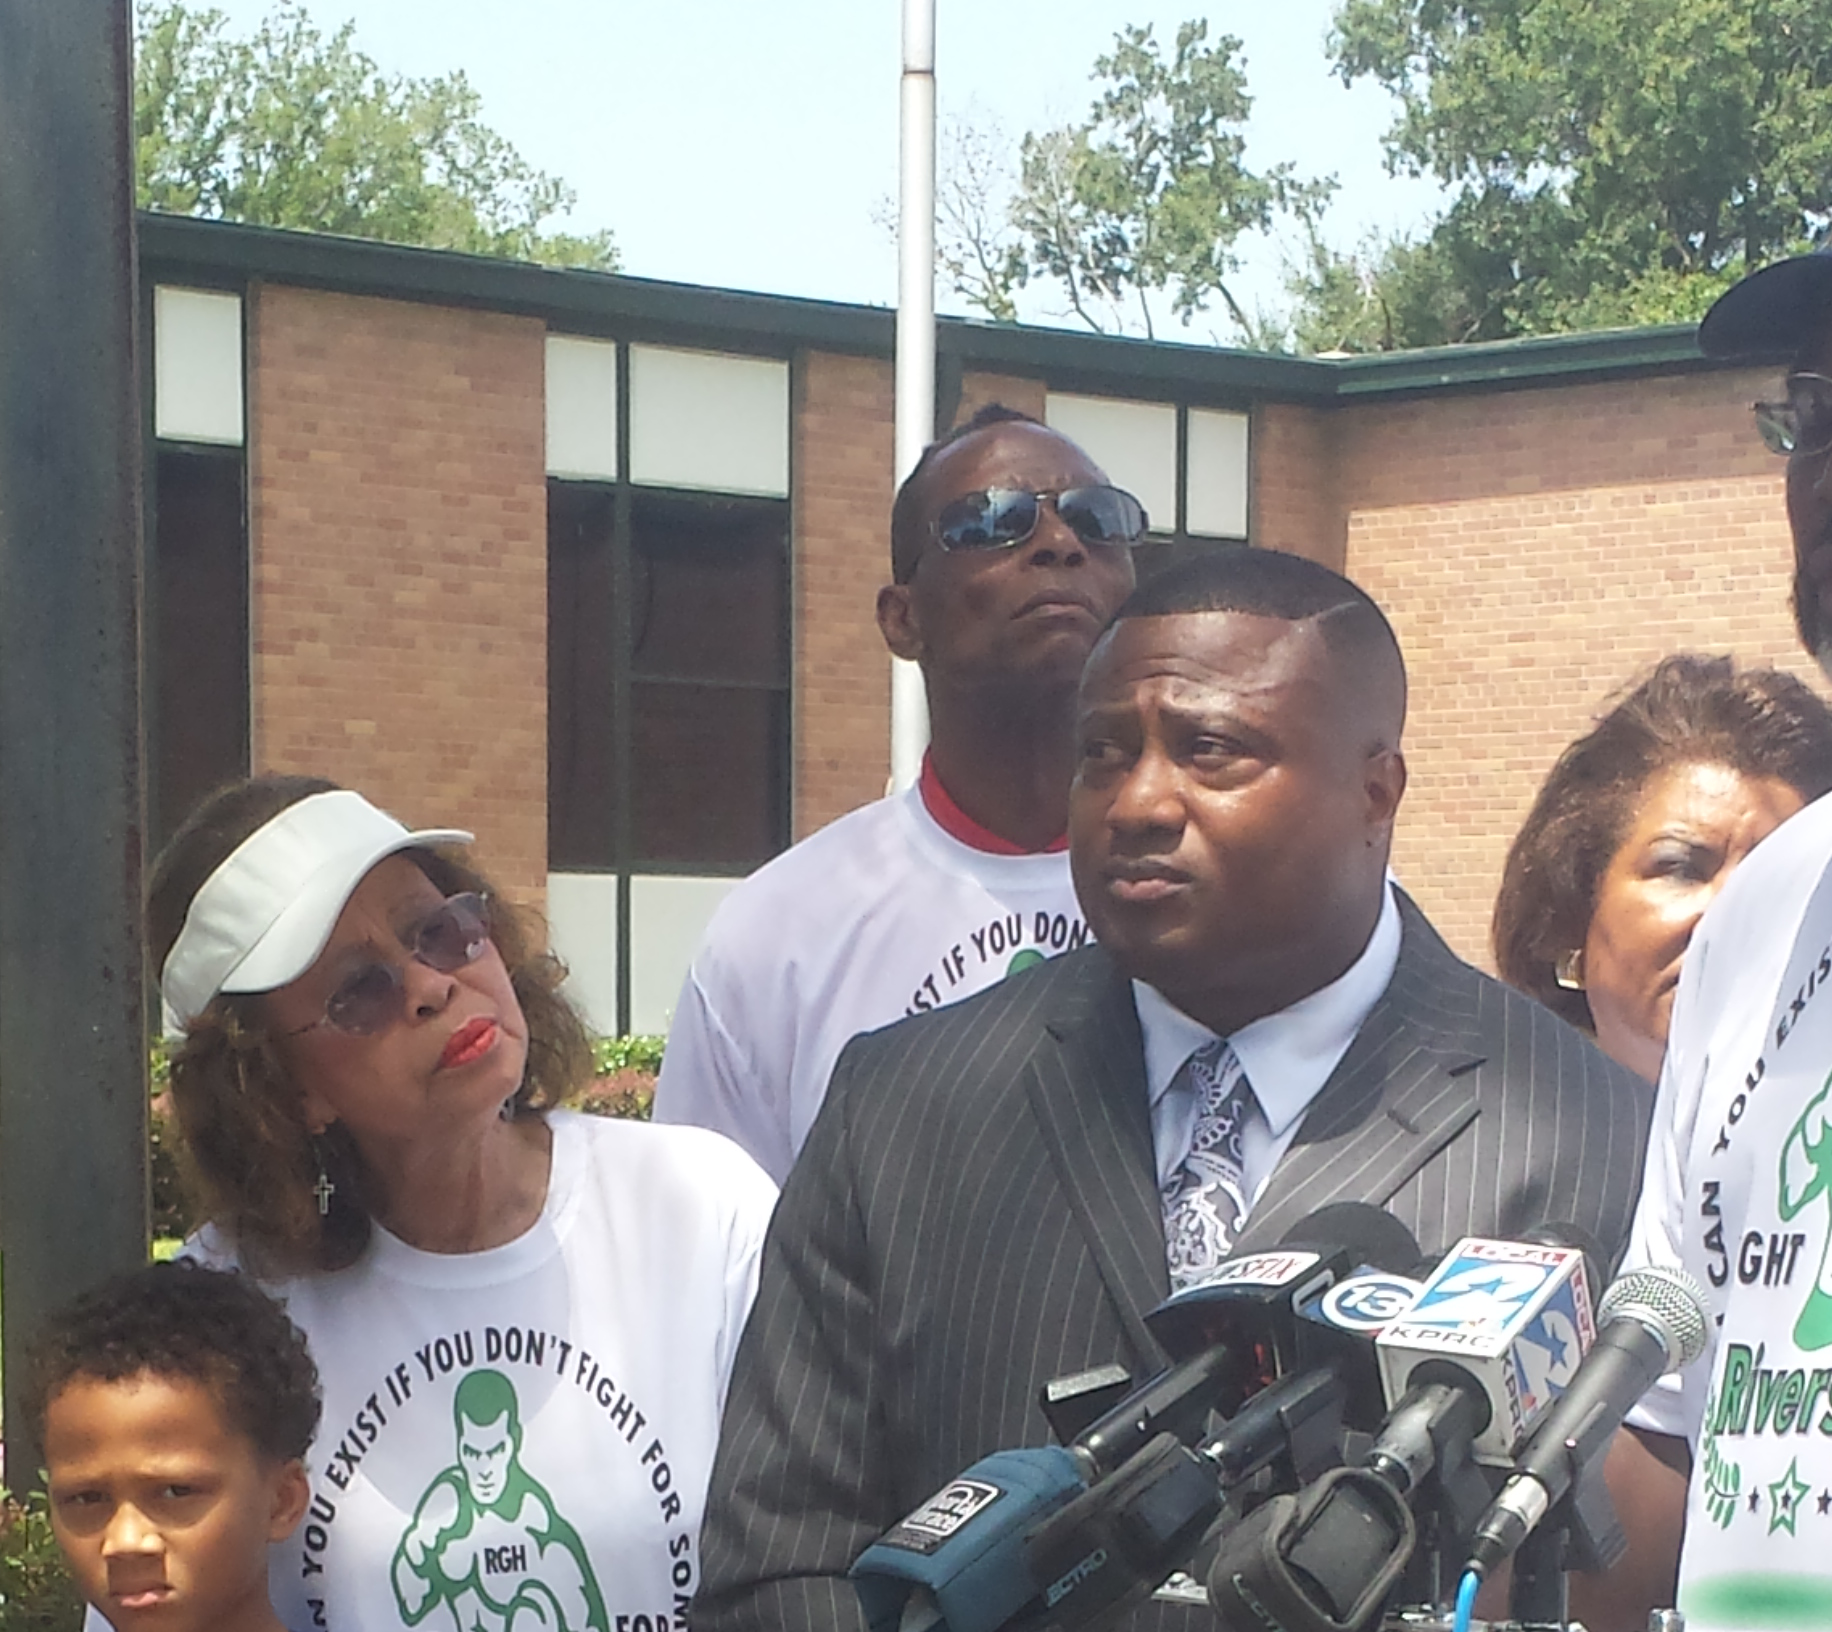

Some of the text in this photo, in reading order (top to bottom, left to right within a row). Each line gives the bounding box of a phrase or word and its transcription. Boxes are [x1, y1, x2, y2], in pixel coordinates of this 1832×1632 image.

[906, 974, 940, 1016] ST
[942, 944, 965, 987] IF
[970, 912, 1022, 963] YOU
[1712, 1057, 1766, 1157] YOU
[1462, 1244, 1567, 1265] LOCAL
[1701, 1180, 1728, 1289] CAN
[1738, 1230, 1806, 1289] GHT
[1341, 1285, 1405, 1318] 13
[1389, 1326, 1496, 1349] KPRC
[302, 1494, 336, 1578] YOU
[325, 1393, 387, 1491] EXIST
[384, 1362, 412, 1407] IF
[414, 1330, 474, 1382] YOU
[485, 1326, 573, 1375] DON'T
[575, 1351, 647, 1443] FIGHT
[641, 1438, 681, 1524] FOR
[484, 1545, 527, 1575] RGH
